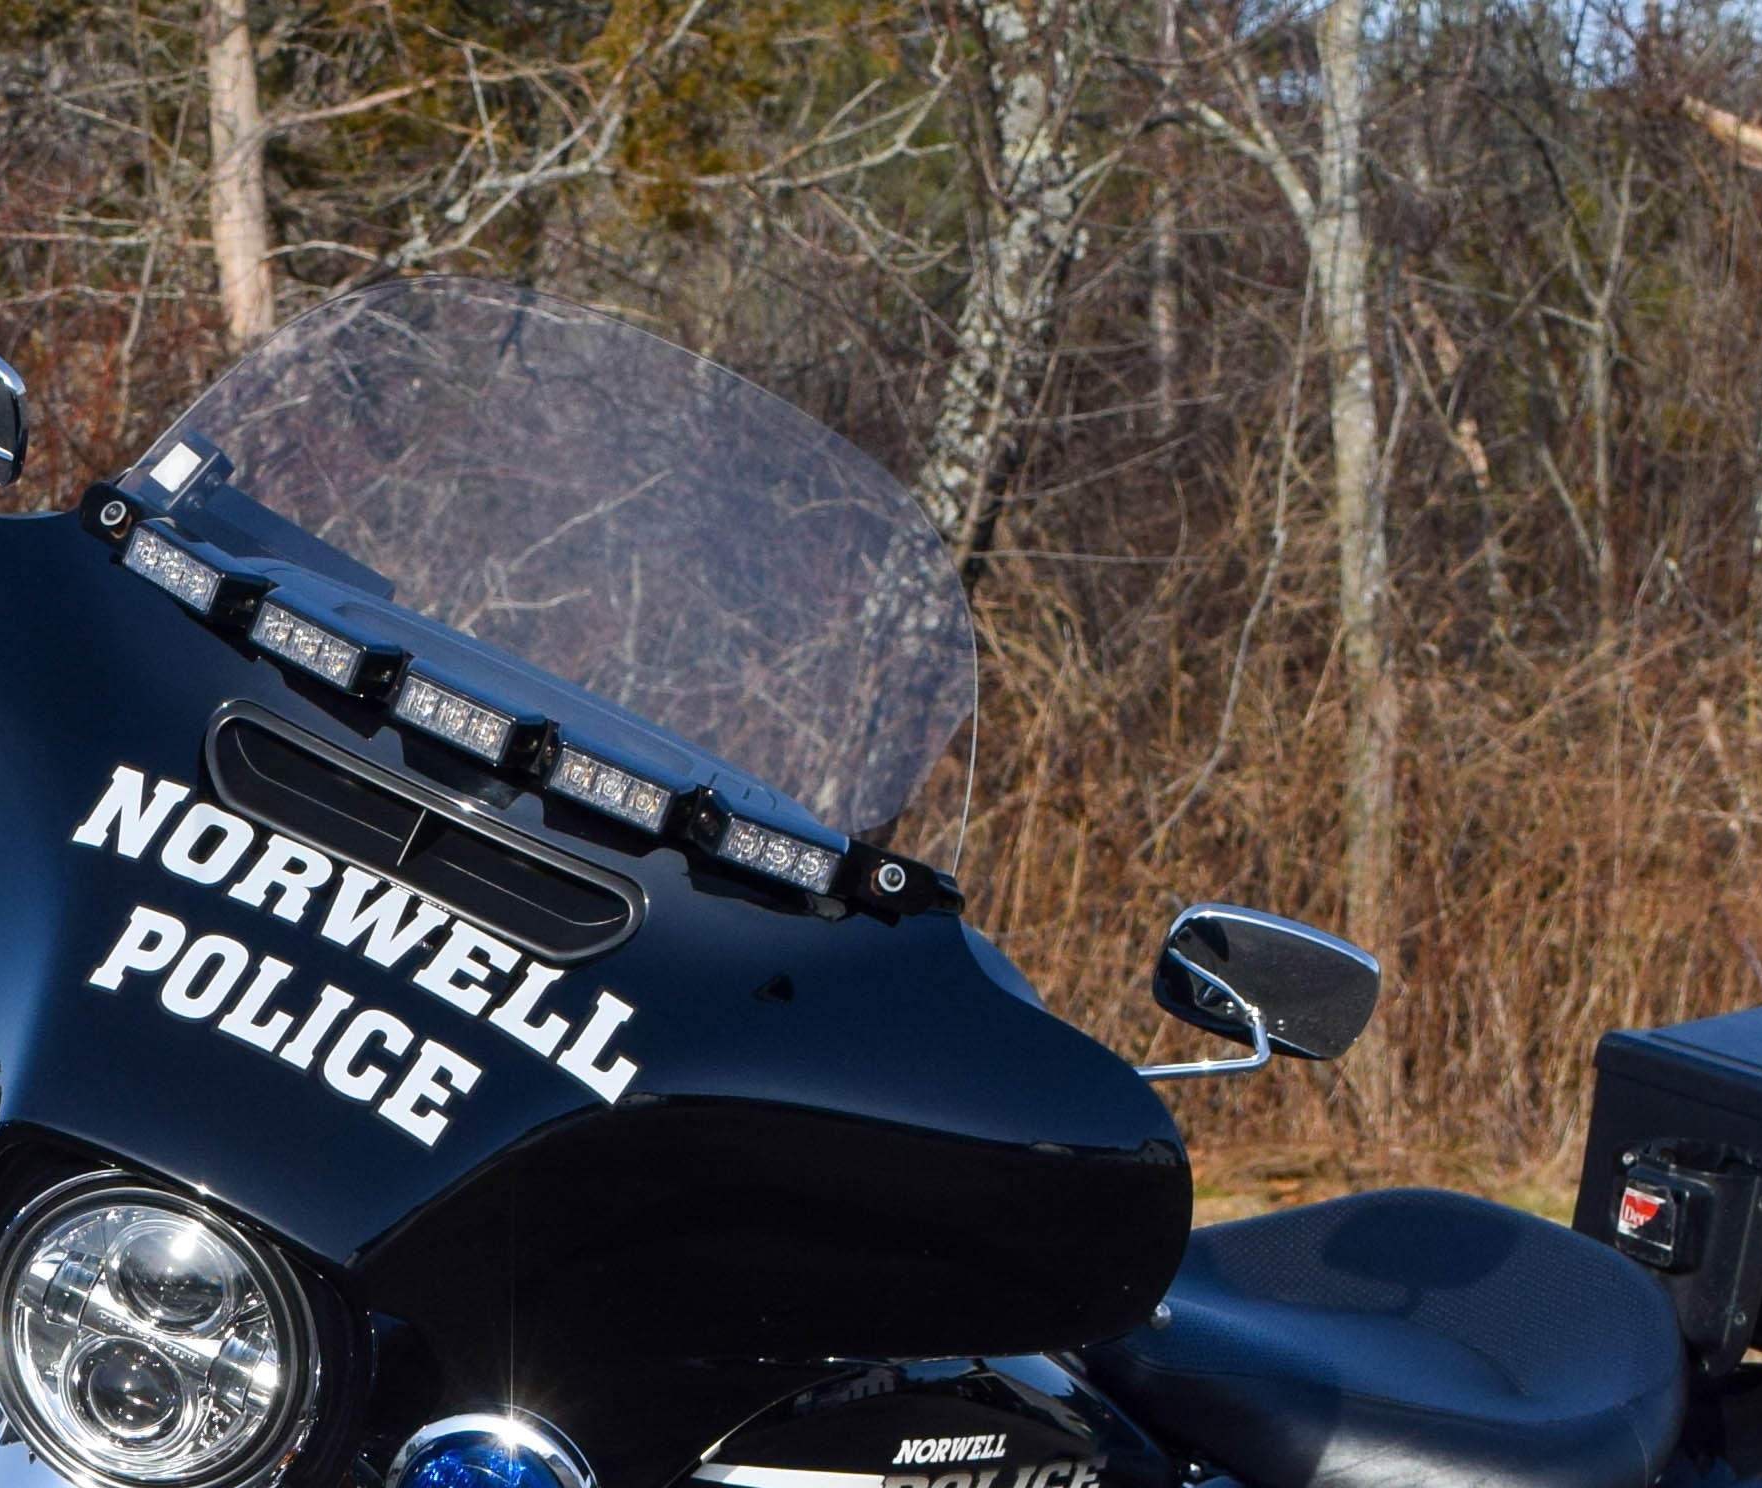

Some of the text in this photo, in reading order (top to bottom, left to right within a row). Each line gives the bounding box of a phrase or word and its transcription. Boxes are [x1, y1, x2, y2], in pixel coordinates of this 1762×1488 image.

[72, 765, 638, 1105] NORWELL
[89, 906, 482, 1146] POLICE
[892, 1433, 1007, 1465] NORWELL
